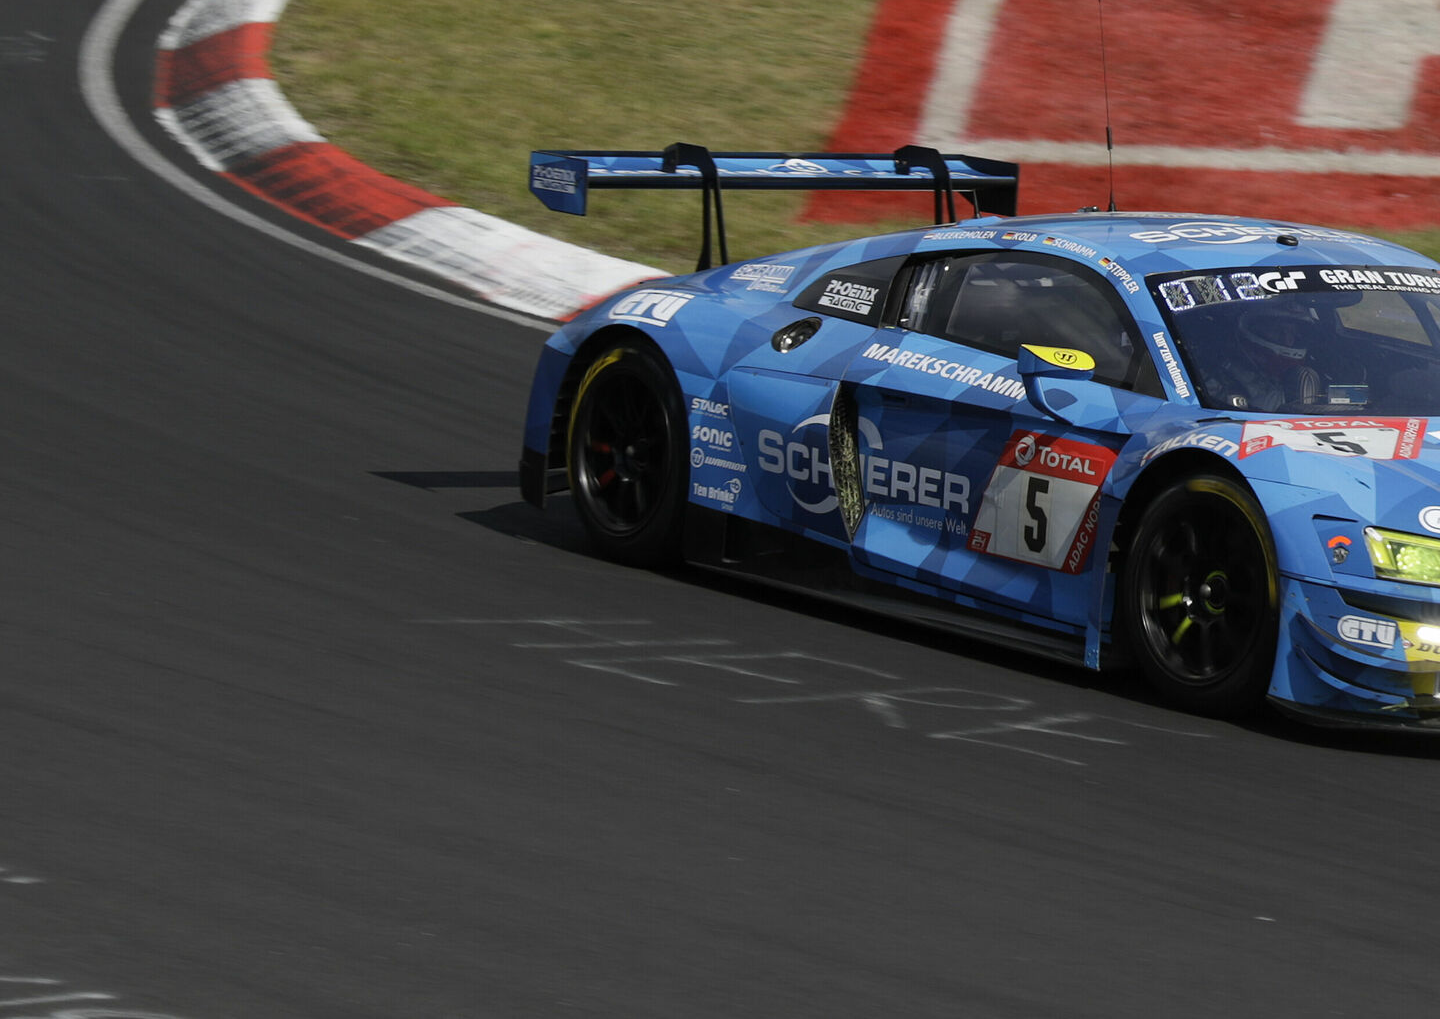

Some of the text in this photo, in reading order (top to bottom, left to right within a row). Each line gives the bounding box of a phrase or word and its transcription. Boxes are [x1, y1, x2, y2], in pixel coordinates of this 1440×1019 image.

[1011, 232, 1038, 243] KOLB
[1052, 237, 1098, 258] SCHRAMM
[1106, 261, 1141, 295] STIPPLER
[1319, 269, 1385, 285] GRAN
[825, 280, 880, 302] PHOENIX
[1387, 285, 1430, 294] DRIVING
[862, 343, 1026, 400] MAREKSCHRAMM
[1294, 419, 1385, 429] TOTAL
[692, 425, 733, 448] SONIC
[1311, 431, 1368, 456] 5
[758, 429, 970, 514] SCHERER
[1038, 445, 1096, 476] TOTAL
[693, 483, 735, 504] Ten Brinke
[870, 502, 895, 520] Autos
[896, 508, 914, 525] sind
[915, 515, 943, 532] unsere
[1024, 476, 1050, 554] 5
[1068, 495, 1101, 573] ADAC NOR
